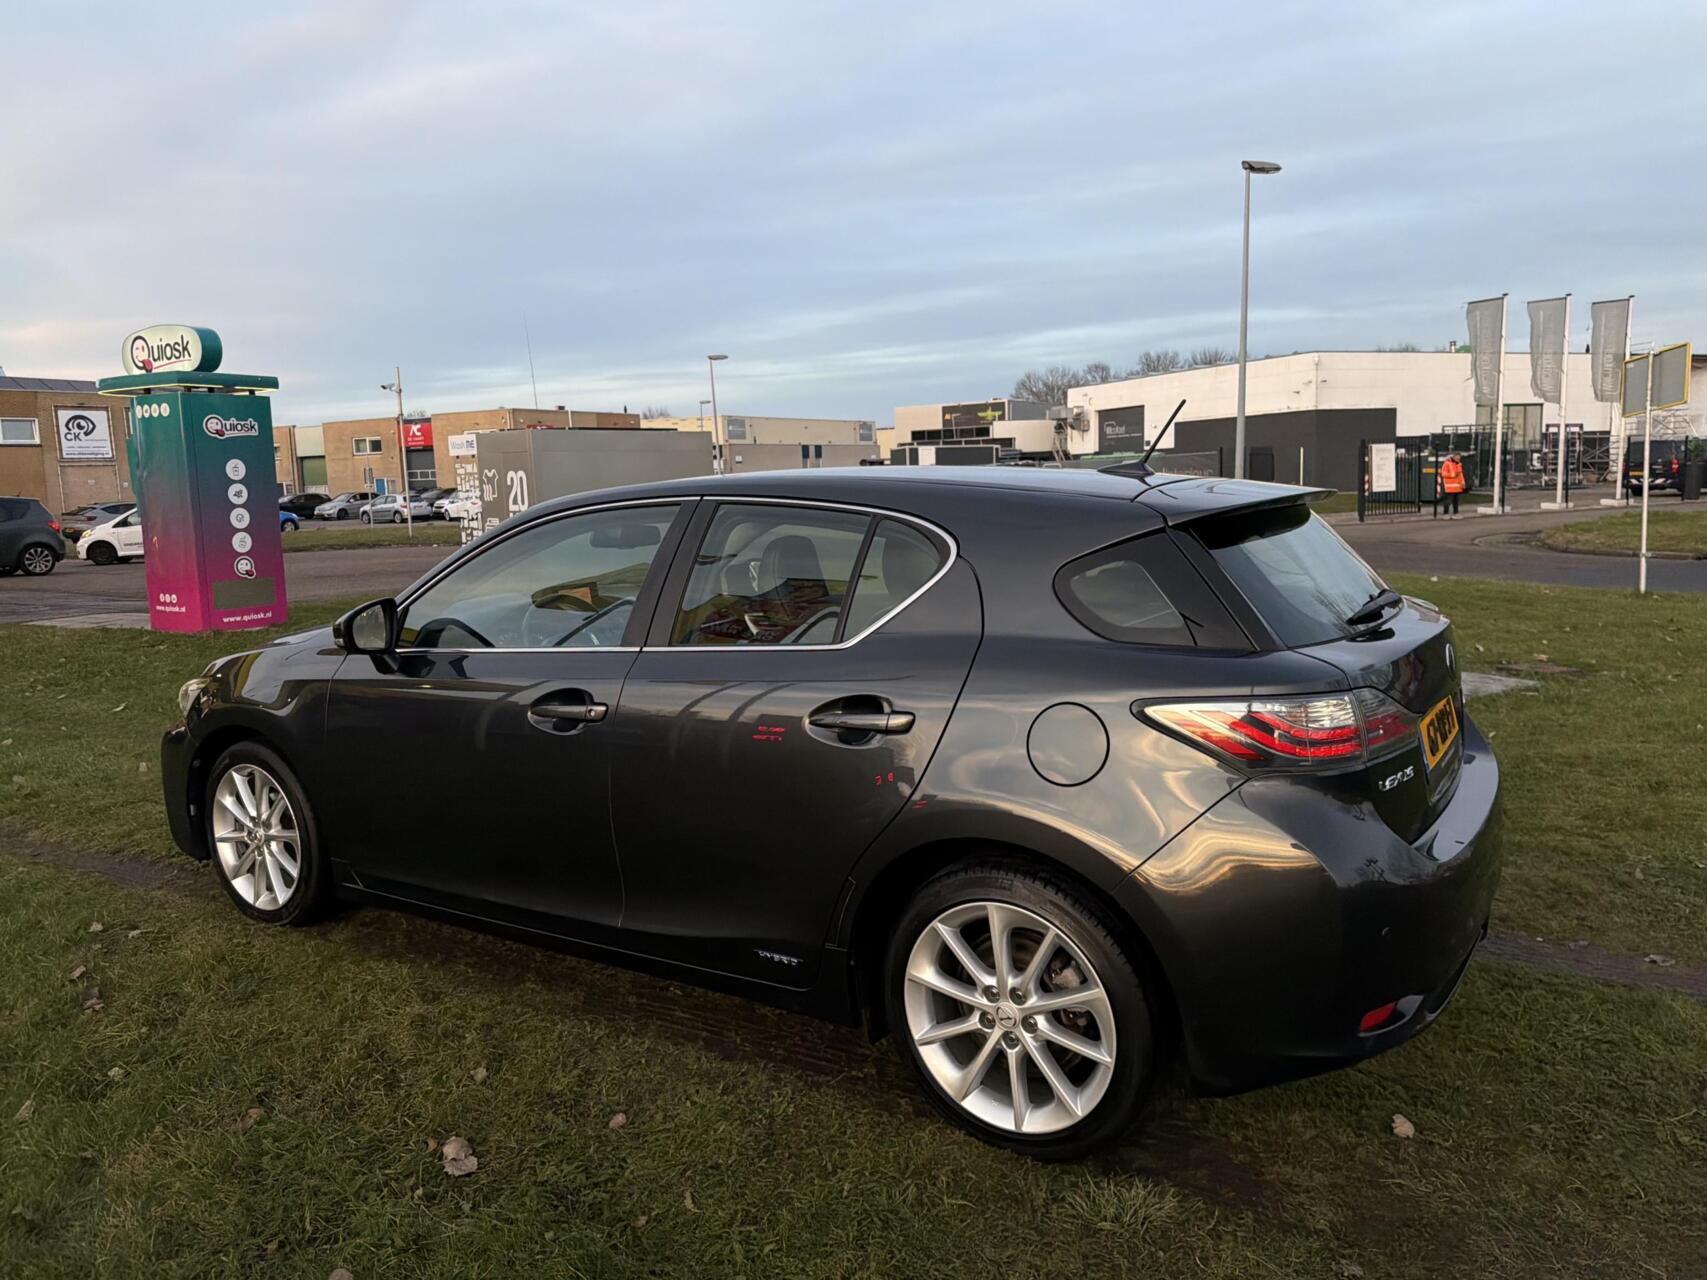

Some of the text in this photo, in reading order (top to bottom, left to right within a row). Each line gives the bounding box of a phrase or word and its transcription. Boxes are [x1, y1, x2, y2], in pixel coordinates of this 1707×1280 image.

[130, 334, 192, 373] Quiosk
[64, 431, 83, 442] CK
[205, 416, 257, 437] Quiosk
[507, 470, 529, 512] 20
[223, 611, 272, 623] www.quiosk.nl
